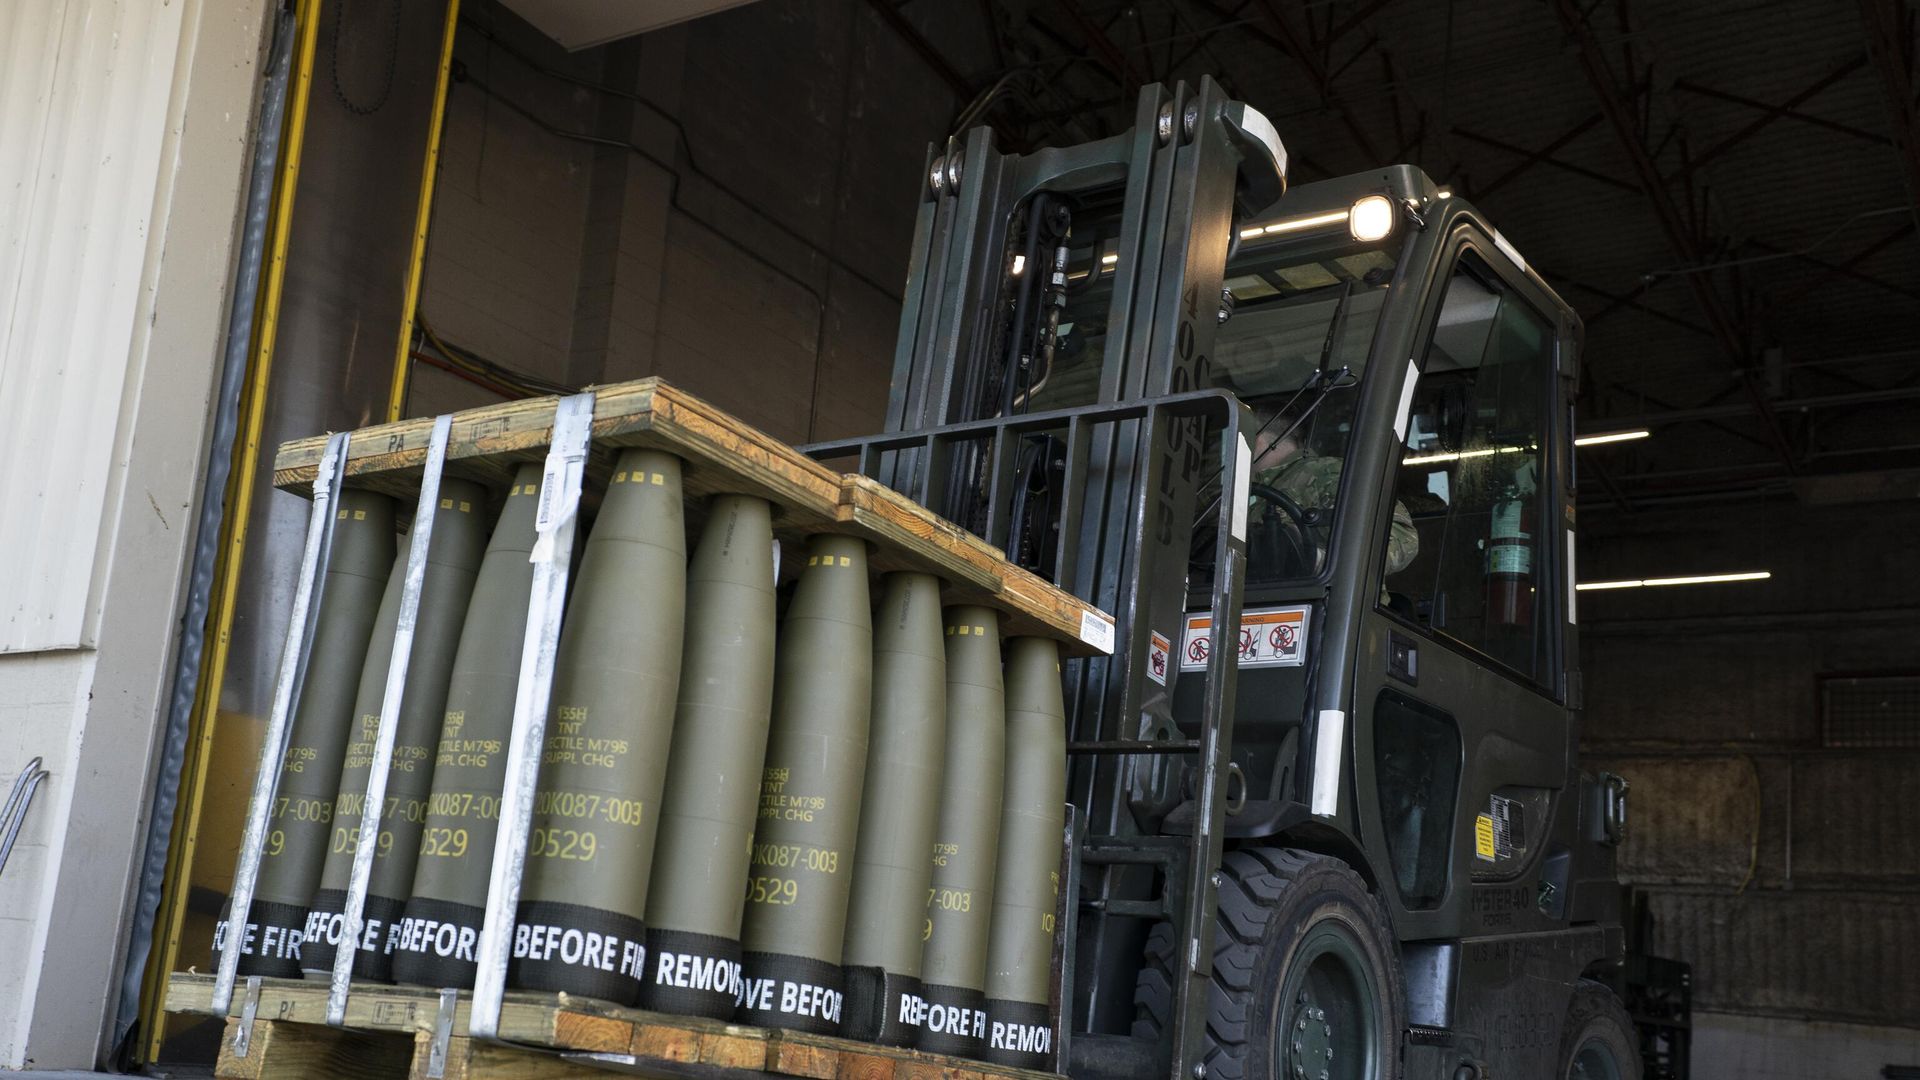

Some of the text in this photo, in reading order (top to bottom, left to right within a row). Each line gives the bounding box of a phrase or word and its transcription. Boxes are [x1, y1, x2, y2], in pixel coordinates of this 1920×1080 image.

[388, 434, 404, 452] PA
[558, 722, 582, 734] TNT
[362, 730, 377, 742] TN
[284, 761, 304, 773] HG
[390, 760, 415, 772] HG
[458, 754, 488, 767] CHG
[582, 753, 615, 768] CHG
[784, 808, 814, 823] CHG
[531, 828, 597, 862] D529
[513, 924, 617, 971] BEFORE
